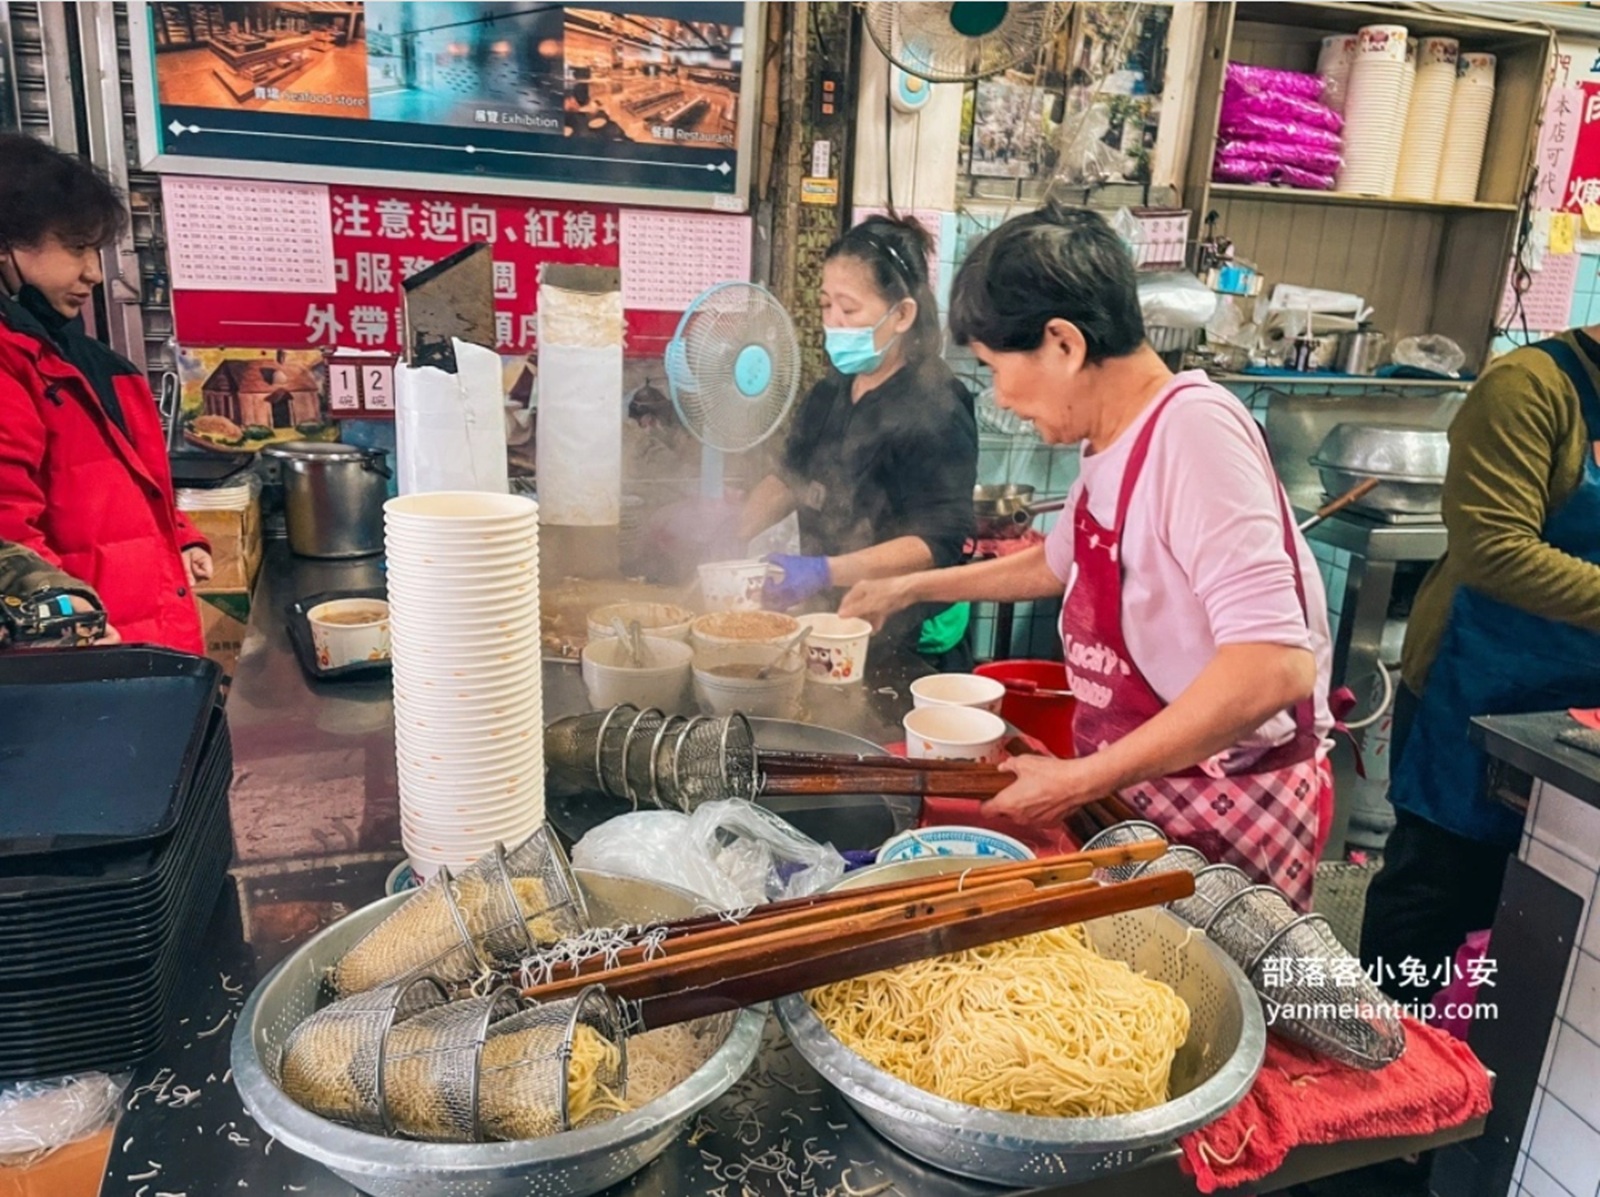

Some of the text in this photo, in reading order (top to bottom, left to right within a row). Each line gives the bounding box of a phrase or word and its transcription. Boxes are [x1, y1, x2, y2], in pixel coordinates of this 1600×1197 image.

[335, 97, 366, 107] store
[501, 113, 558, 128] Exhibition
[676, 129, 734, 144] Restaurant
[340, 370, 383, 390] 1 2
